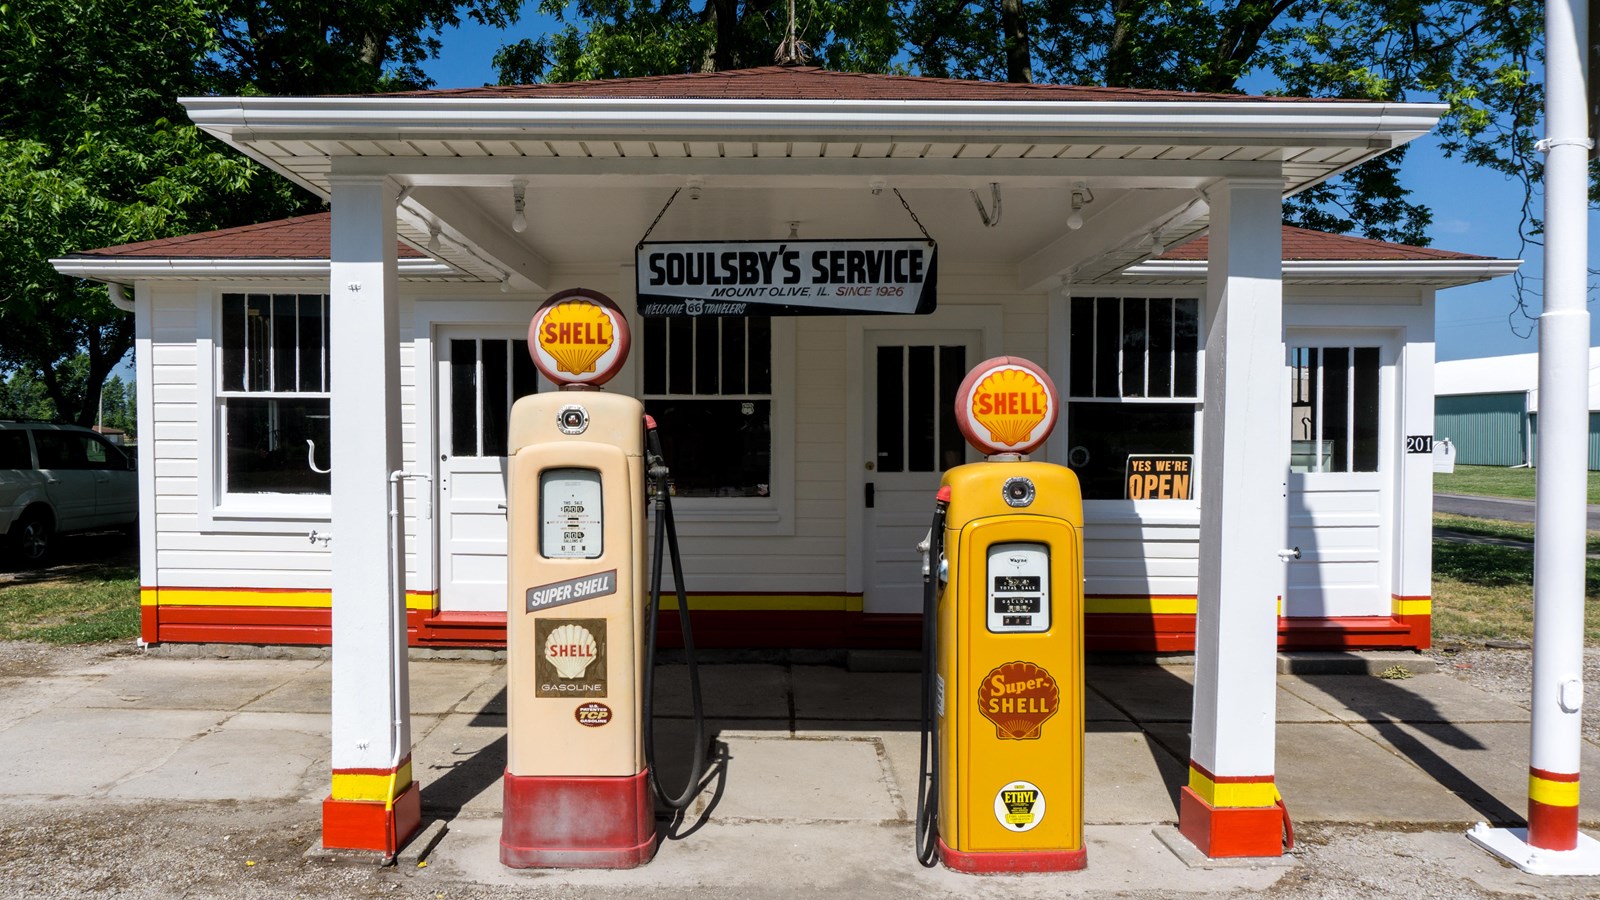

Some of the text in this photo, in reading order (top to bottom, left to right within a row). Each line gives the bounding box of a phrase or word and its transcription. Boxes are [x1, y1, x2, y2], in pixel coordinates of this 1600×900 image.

[649, 245, 923, 286] SOULSBY'S SERVICE
[711, 287, 904, 298] MOUNT OLIVE, IL. SINCE 1926
[645, 303, 747, 315] WELCOME 66 TRAVELERS
[544, 322, 608, 345] SHELL
[978, 392, 1042, 415] SHELL
[1407, 437, 1431, 451] 201
[1132, 461, 1188, 471] YES WE'RE
[1129, 474, 1189, 500] OPEN
[532, 576, 609, 606] SUPER SHELL
[550, 644, 593, 657] SHELL
[988, 698, 1050, 714] SHELL
[579, 711, 608, 719] TCP
[1004, 791, 1036, 803] ETHYL
